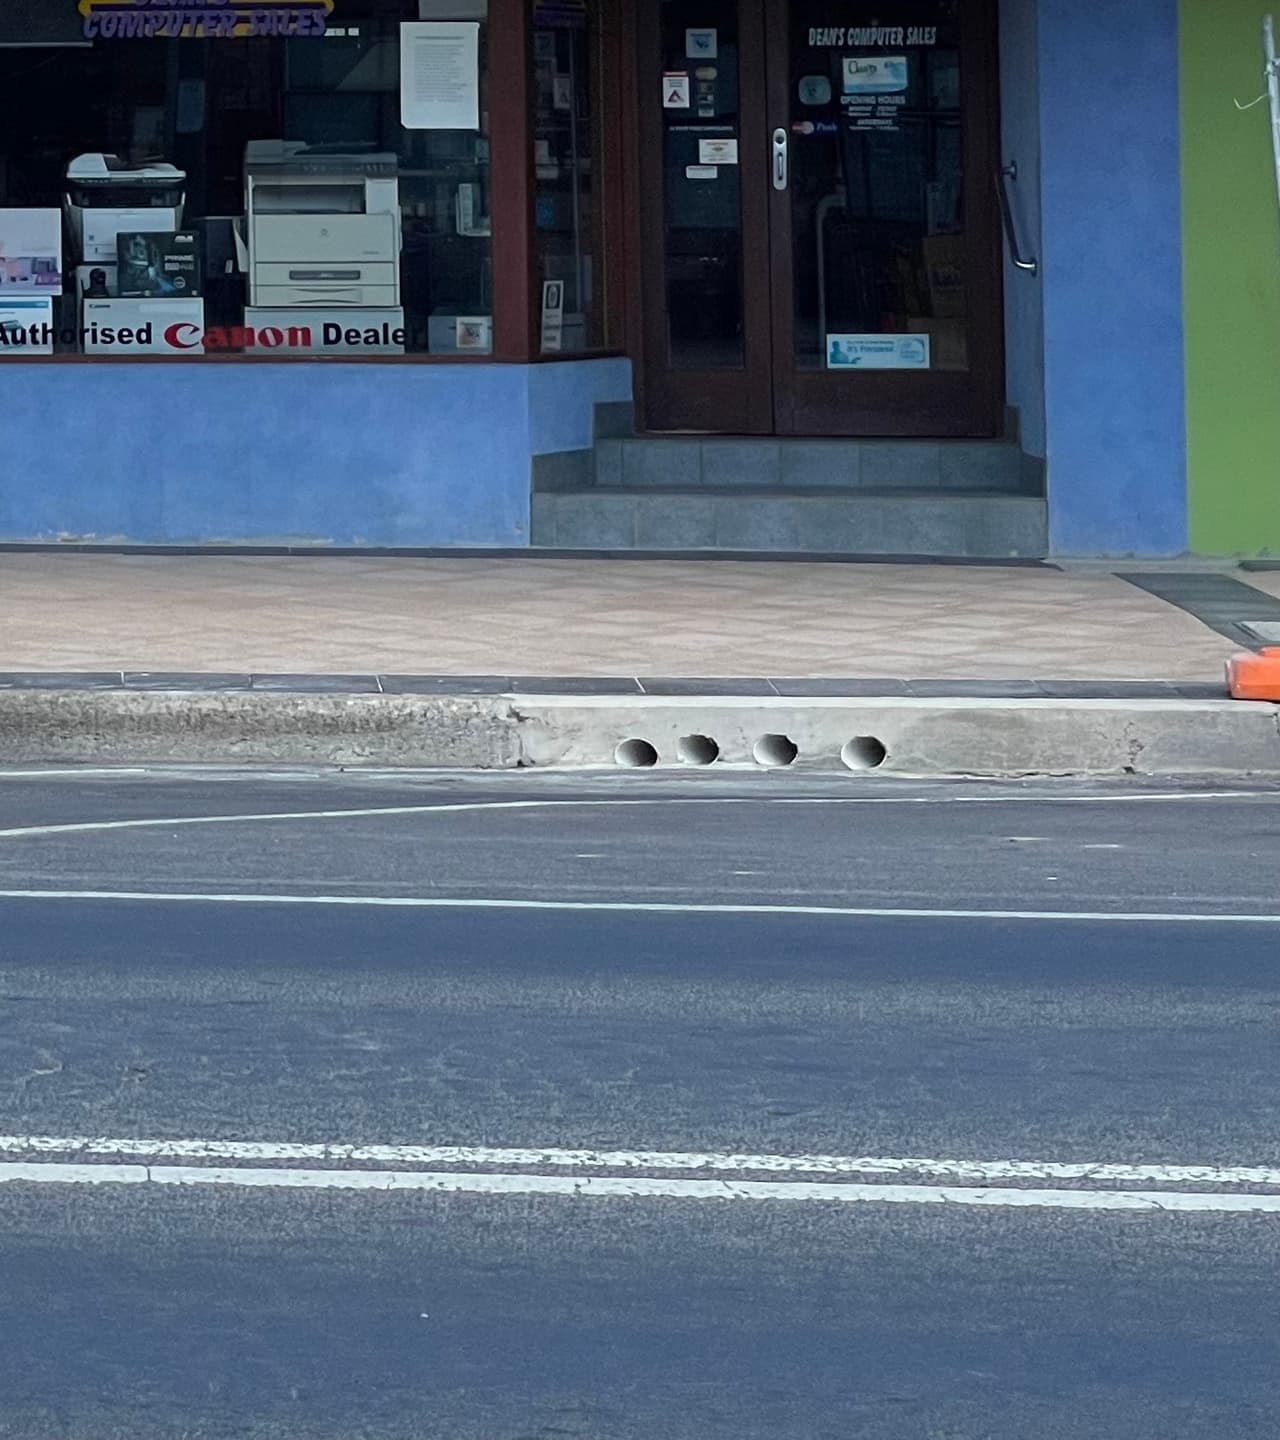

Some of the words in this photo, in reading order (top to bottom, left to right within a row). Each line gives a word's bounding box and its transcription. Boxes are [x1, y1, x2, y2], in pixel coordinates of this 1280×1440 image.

[82, 9, 240, 39] COMPUTER
[247, 7, 328, 37] SALES
[808, 27, 845, 46] DEAN'S
[847, 26, 904, 46] COMPUTER
[906, 26, 936, 45] SALES
[164, 323, 312, 349] Canon
